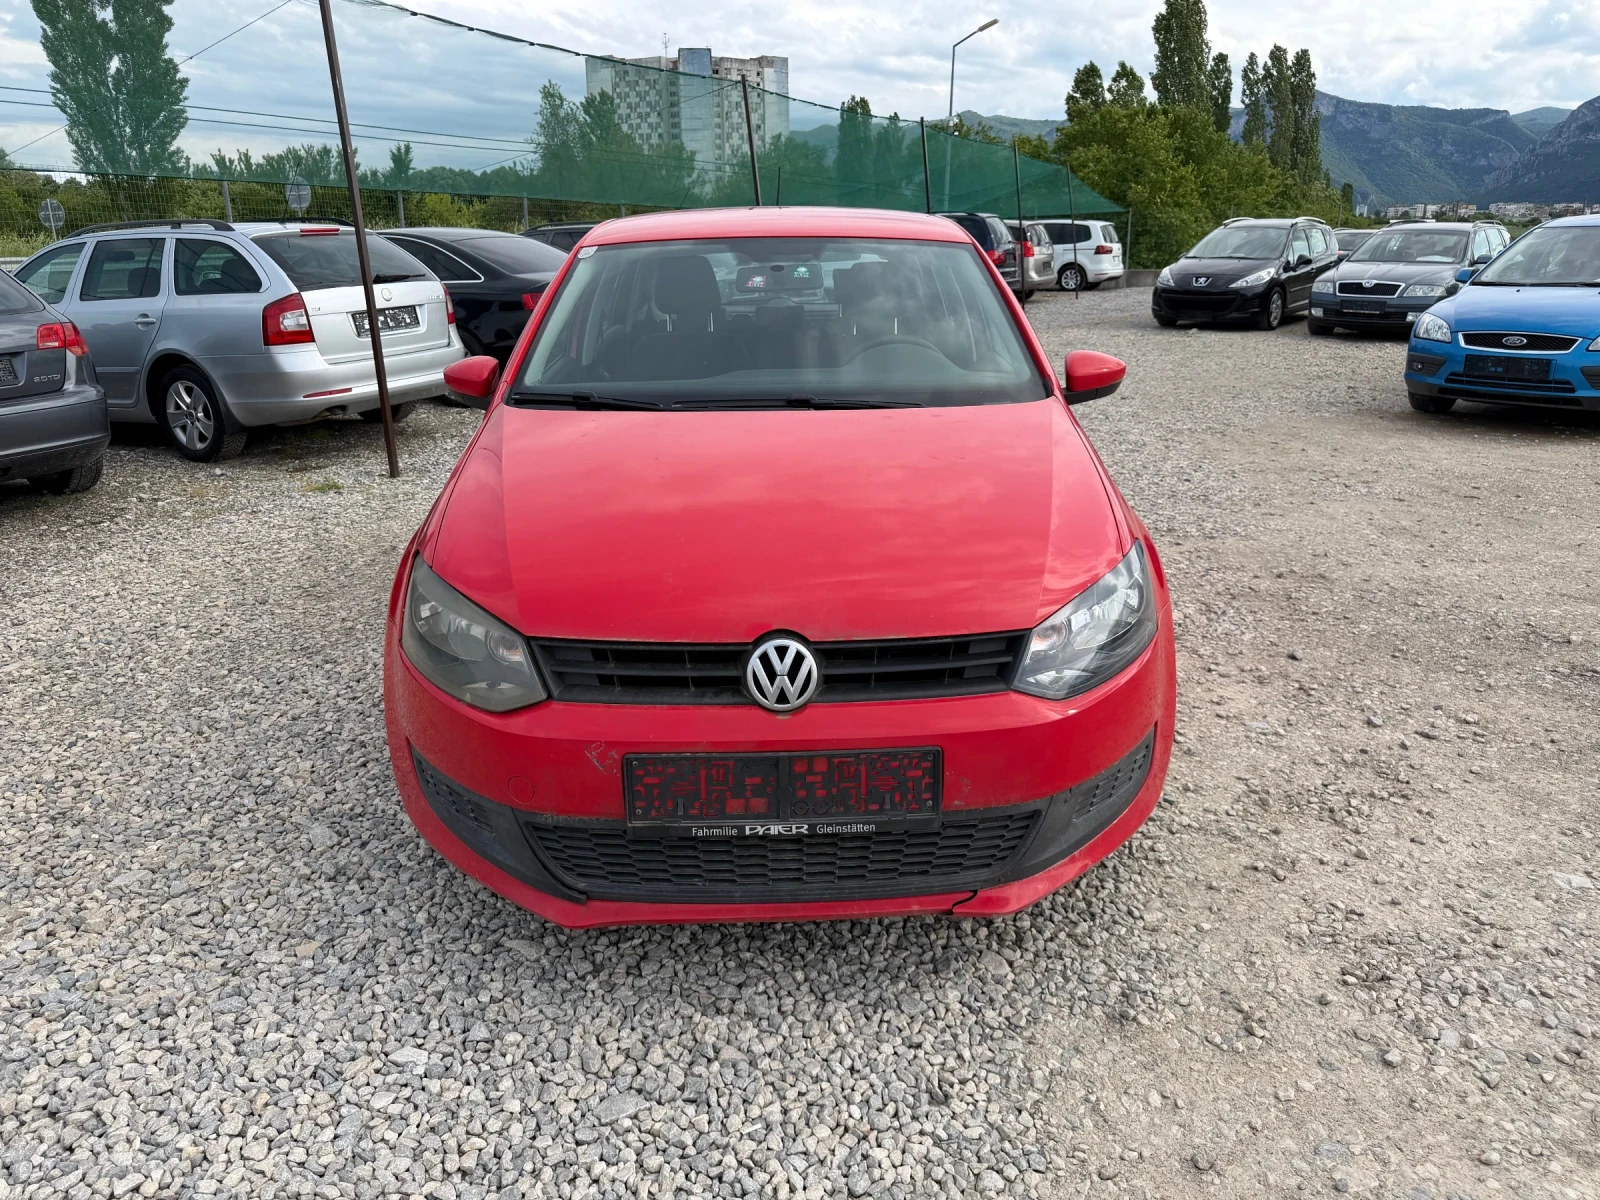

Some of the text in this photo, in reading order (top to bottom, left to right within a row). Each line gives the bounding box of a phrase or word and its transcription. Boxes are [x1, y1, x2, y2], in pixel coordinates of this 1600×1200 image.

[747, 639, 817, 711] VW
[692, 823, 876, 837] Fahrmilie PAIER Gleinstätten
